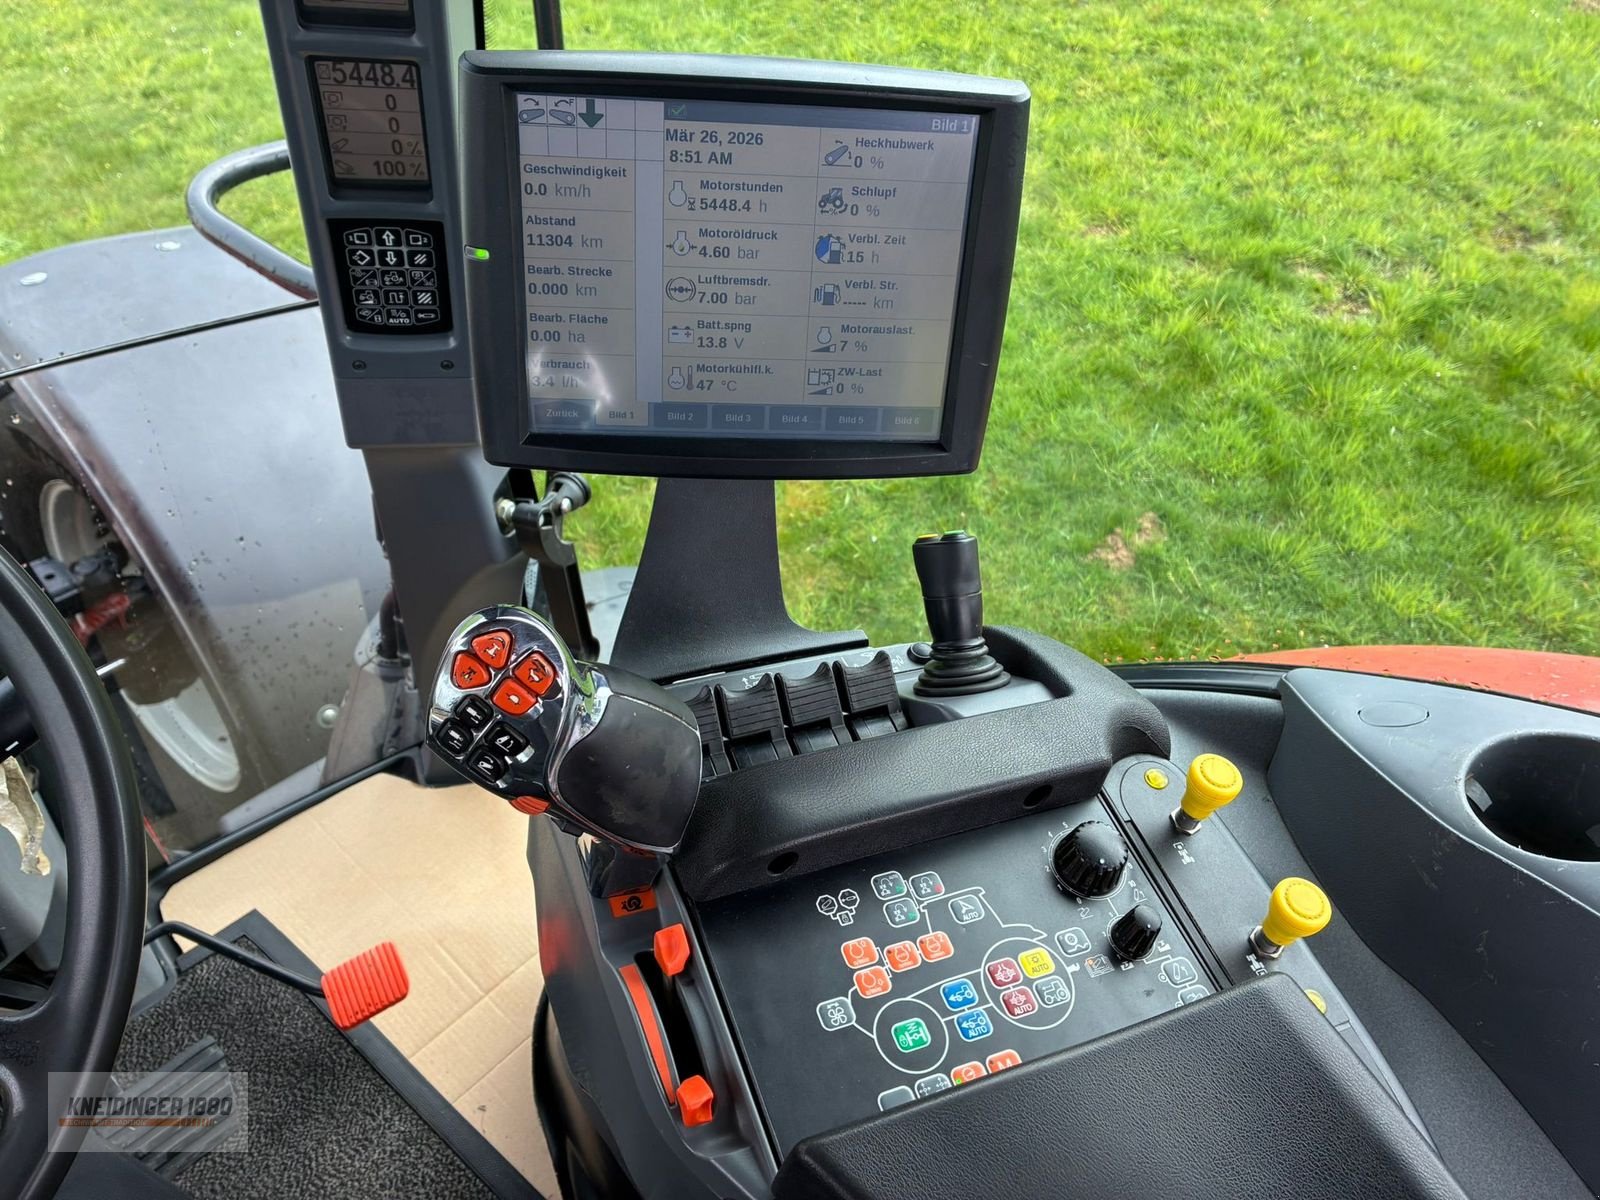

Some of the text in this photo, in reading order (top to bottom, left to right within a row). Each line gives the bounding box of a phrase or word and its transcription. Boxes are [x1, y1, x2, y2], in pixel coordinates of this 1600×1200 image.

[332, 61, 416, 88] 5448.4
[385, 94, 397, 112] 0
[388, 117, 400, 134] 0
[931, 118, 969, 132] Bild 1
[665, 128, 764, 146] Mär 26, 2026
[855, 137, 934, 150] Heckhubwerk
[392, 140, 422, 156] 0 %
[670, 150, 733, 165] 8:51 AM
[854, 156, 884, 169] 0 %
[373, 160, 425, 176] 100 %
[523, 163, 628, 179] Geschwindigkeit
[524, 183, 592, 198] 0.0 km/h
[700, 180, 784, 193] Motorstunden
[851, 186, 896, 200] Schlupf
[700, 198, 768, 212] 5448.4 h
[850, 204, 880, 217] 0 %
[526, 215, 576, 226] Abstand
[698, 228, 778, 240] Motoröldruck
[848, 233, 906, 246] Verbl. Zeit
[527, 234, 604, 248] 11304 km
[698, 246, 760, 260] 4.60 bar
[847, 251, 880, 264] 15 h
[528, 264, 613, 277] Bearb. Strecke
[698, 274, 771, 286] Luftbremsdr.
[845, 280, 898, 290] Verbl. Str.
[528, 282, 598, 296] 0.000 km
[698, 292, 757, 305] 7.00 bar
[873, 296, 894, 310] km
[530, 312, 609, 324] Bearb. Fläche
[697, 320, 752, 333] Batt.spng
[530, 330, 586, 343] 0.00 ha
[697, 336, 744, 350] 13.8 V
[840, 340, 868, 352] 7 %
[837, 368, 882, 377] ZW-Last
[532, 376, 554, 387] 3.4
[696, 380, 738, 392] 47 °C
[836, 382, 864, 394] 0 %
[546, 407, 579, 418] Zurück
[608, 410, 627, 419] Bild
[668, 412, 694, 421] Bild 2
[726, 414, 752, 422] Bild 3
[782, 415, 808, 423] Bild 4
[838, 416, 864, 424] Bild 5
[894, 417, 912, 425] Bild
[962, 910, 979, 922] AUTO
[1031, 963, 1050, 974] AUTO
[1014, 1003, 1033, 1016] AUTO
[968, 1026, 988, 1038] AUTO
